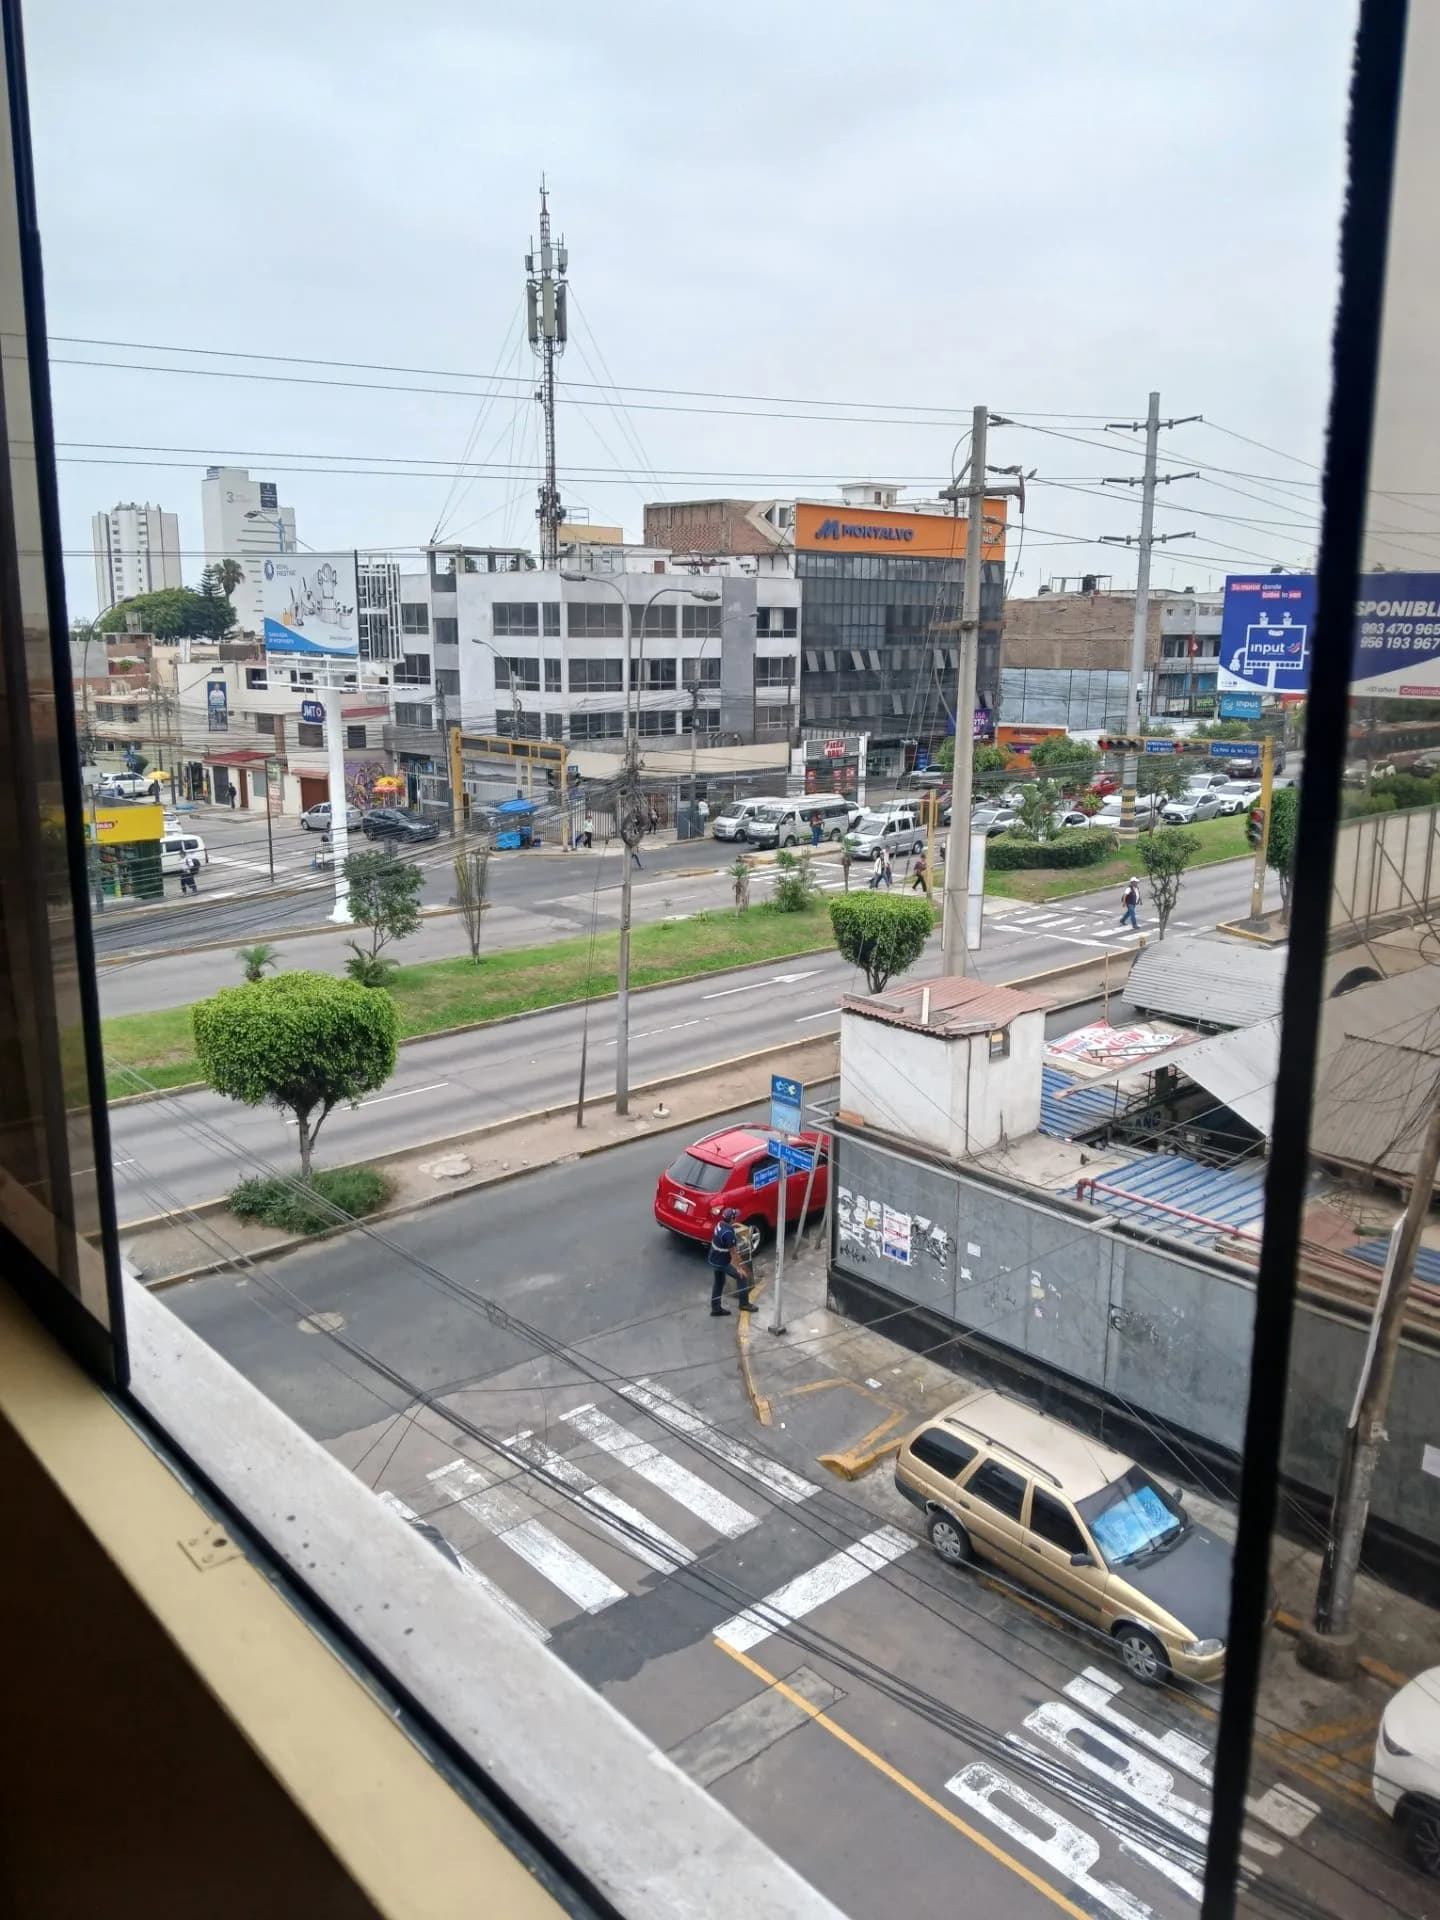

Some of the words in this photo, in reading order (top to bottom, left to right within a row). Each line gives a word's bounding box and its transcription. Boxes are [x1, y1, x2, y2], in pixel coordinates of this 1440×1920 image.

[842, 524, 914, 542] MONTALVO
[1356, 600, 1440, 617] SPONIBL
[1386, 623, 1413, 635] 470
[1415, 624, 1440, 635] 965
[1250, 643, 1286, 655] input
[1387, 637, 1411, 649] 193
[1413, 637, 1440, 649] 967
